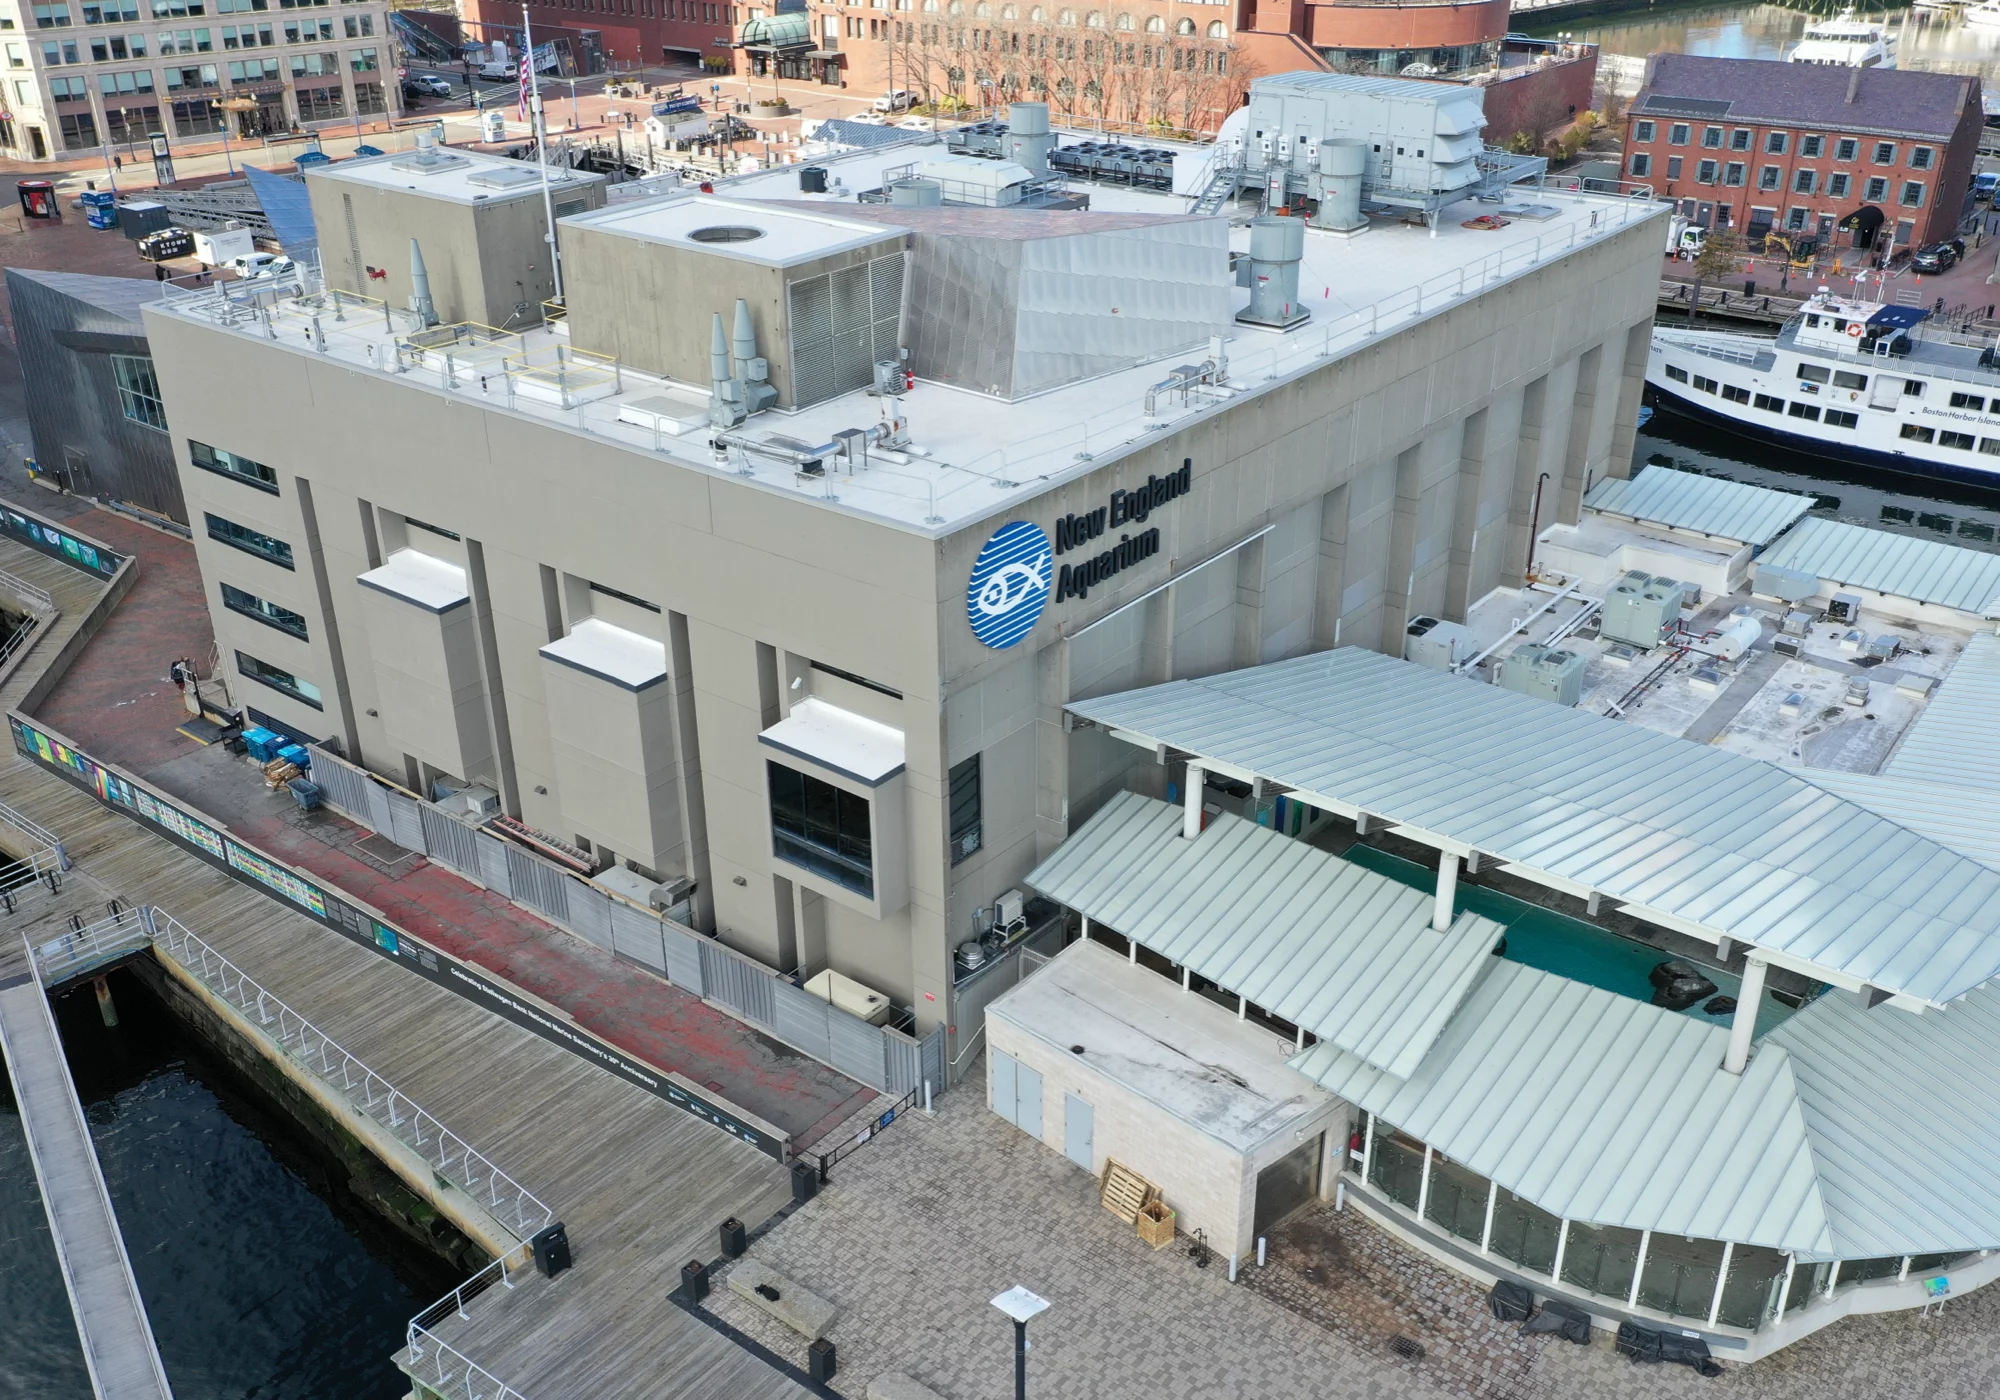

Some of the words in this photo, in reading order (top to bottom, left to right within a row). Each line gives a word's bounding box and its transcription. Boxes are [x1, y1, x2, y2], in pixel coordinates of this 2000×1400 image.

[1922, 406, 1948, 418] Boston
[1948, 410, 1977, 423] Harbor
[1055, 505, 1107, 556] New
[1109, 457, 1192, 530] England
[1055, 527, 1160, 604] Aquarium
[450, 967, 482, 991] Celebrating
[512, 1001, 528, 1015] Bank
[527, 1009, 552, 1029] National
[551, 1022, 573, 1040] Marine
[573, 1035, 608, 1060] Sanctuary's
[620, 1062, 658, 1089] Anniversary
